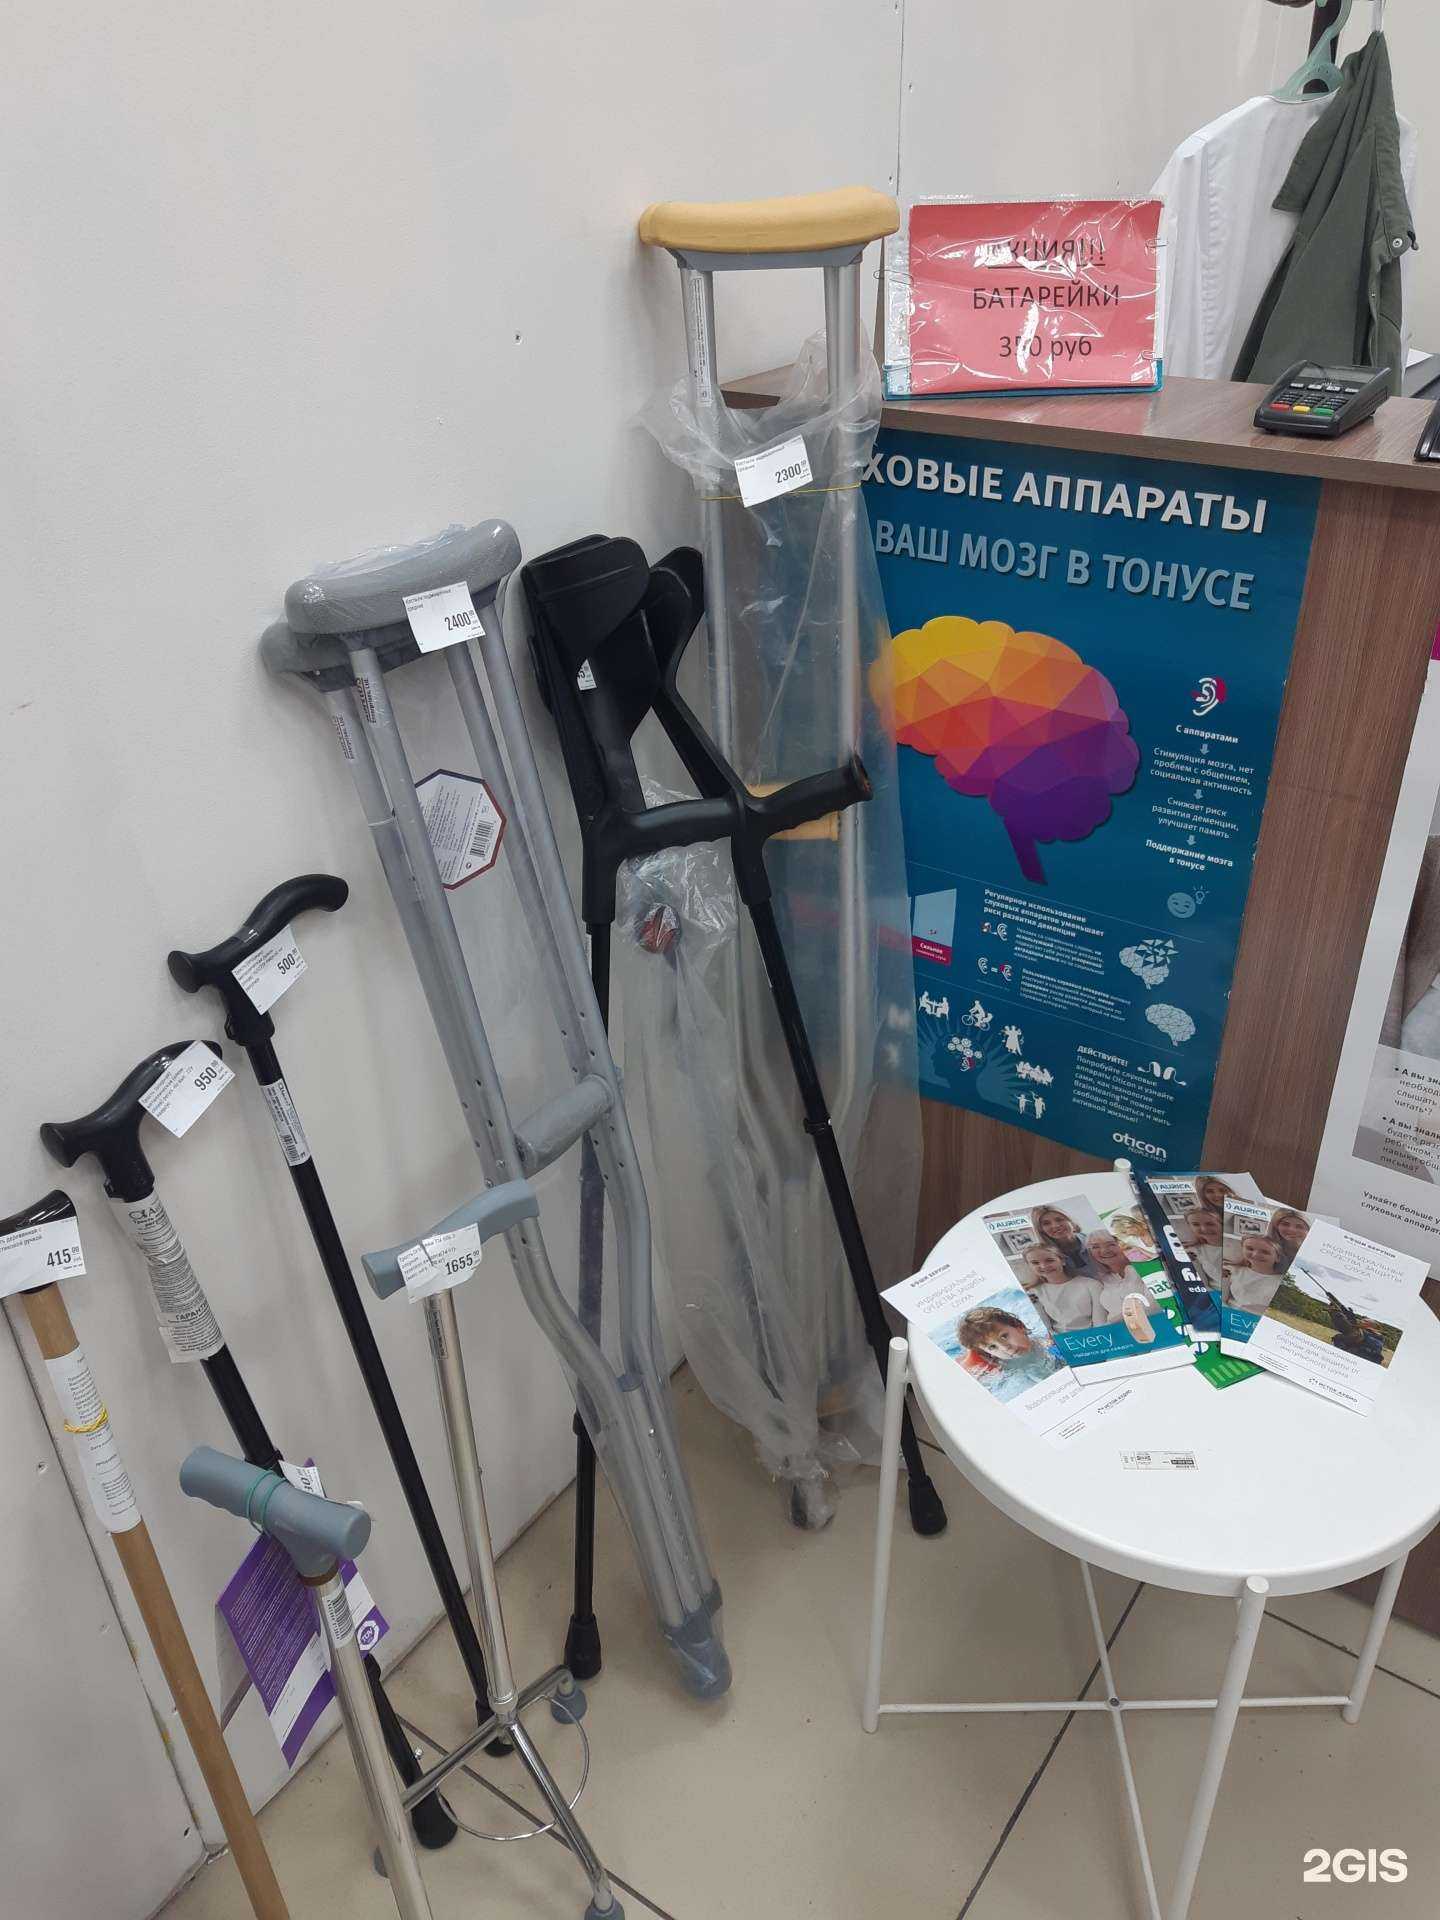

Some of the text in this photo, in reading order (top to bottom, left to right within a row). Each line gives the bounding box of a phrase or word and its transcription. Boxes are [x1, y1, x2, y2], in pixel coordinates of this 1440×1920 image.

[985, 236, 1105, 267] КЦИЯ!!!
[973, 280, 1119, 310] БАТАРЕЙКИ
[1051, 335, 1093, 363] руб
[775, 463, 801, 484] 2300
[1012, 471, 1267, 534] АППАРАТЫ
[875, 519, 1255, 610] ВАШ МОЗГ В ТОНУСЕ
[444, 611, 471, 631] 2400
[1175, 724, 1239, 744] С аппаратами
[1153, 746, 1206, 766] Стимуляция
[1153, 757, 1191, 773] проблем
[1149, 768, 1200, 786] социальная
[1151, 804, 1190, 820] развития
[1167, 796, 1203, 812] Снижает
[1145, 839, 1233, 867] Поддержание мозга
[1175, 858, 1205, 872] тонусе
[277, 953, 296, 975] 500
[1077, 1045, 1128, 1066] ДЕЙСТВУЙТЕ!
[194, 1066, 218, 1091] 950
[1112, 1131, 1167, 1159] oticon
[1233, 1204, 1267, 1217] AURICA
[1361, 1201, 1402, 1220] слуховых
[1362, 1190, 1397, 1209] Узнайте
[1399, 1202, 1434, 1223] больше
[47, 1248, 71, 1267] 415
[445, 1253, 473, 1275] 1655
[1064, 1332, 1113, 1352] Every
